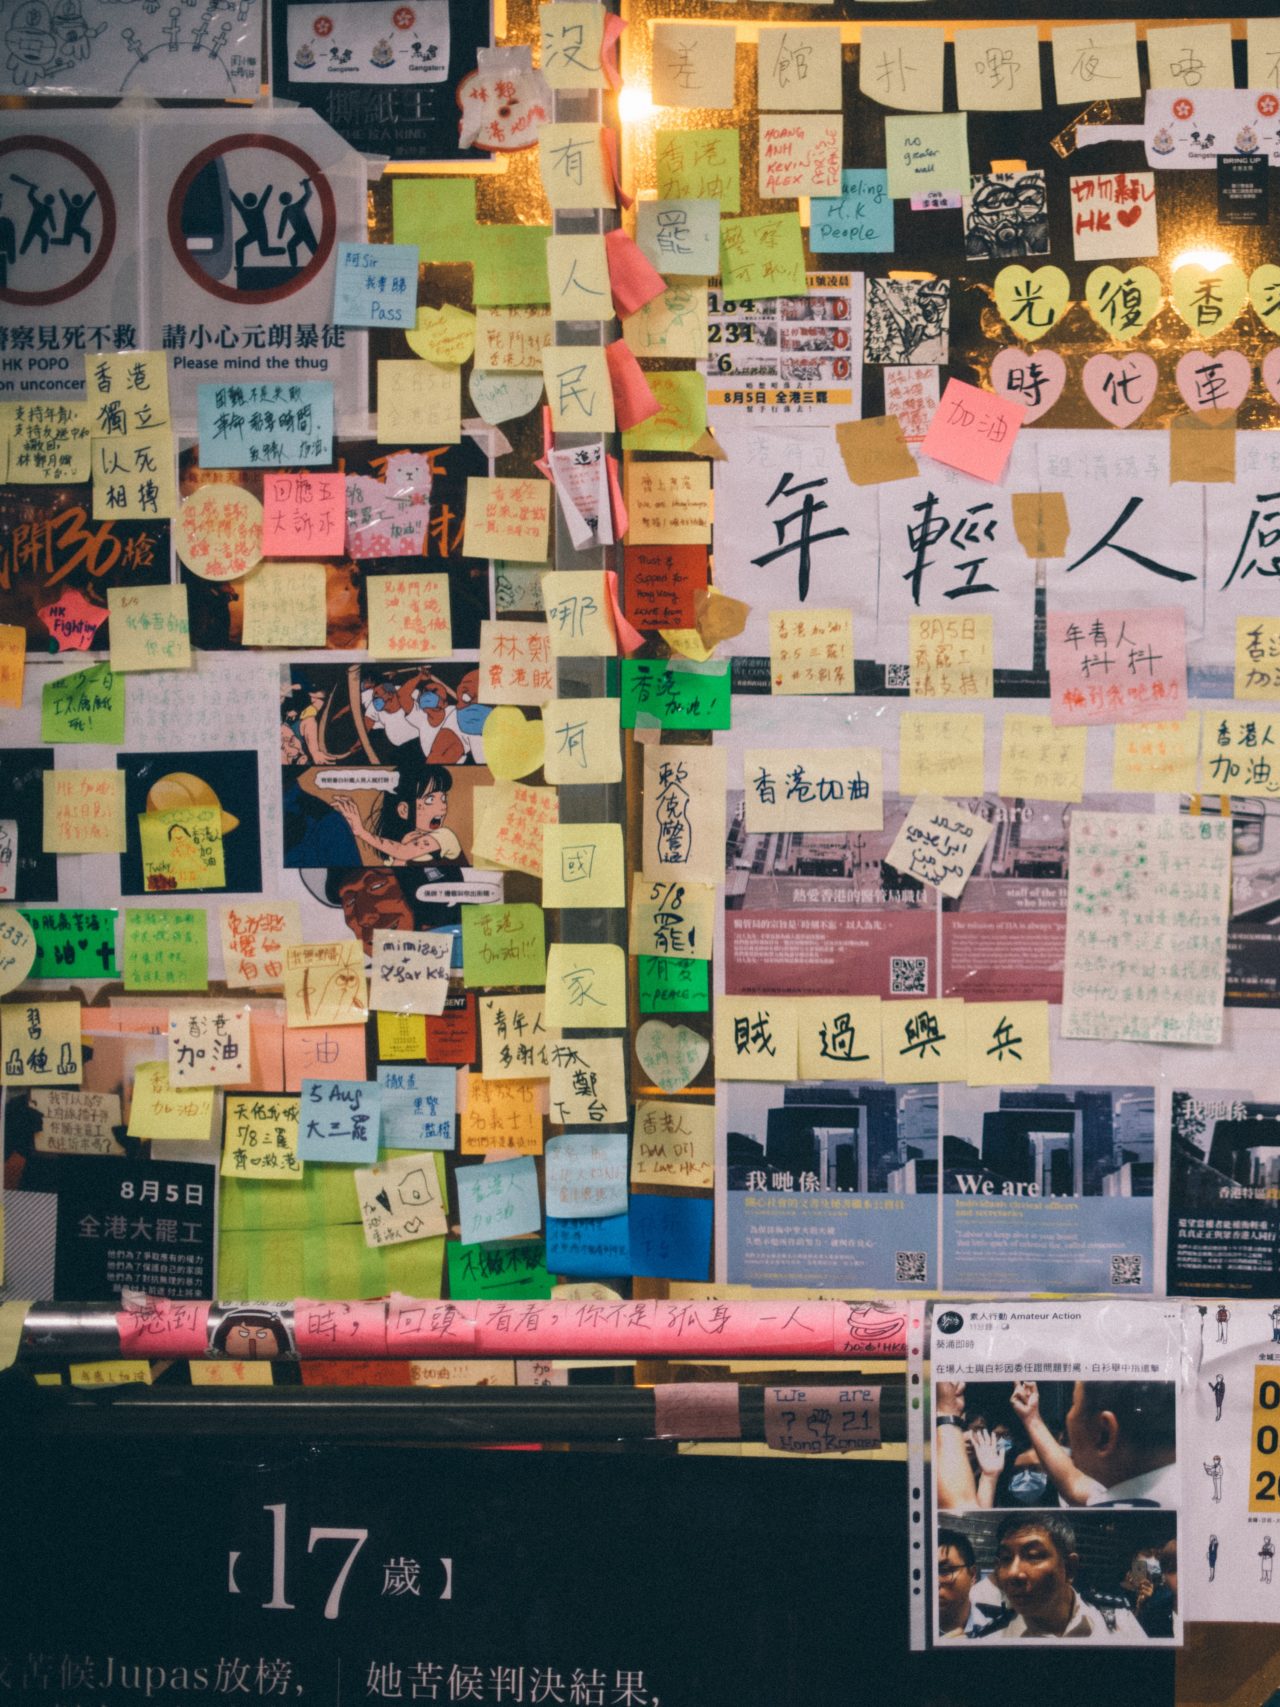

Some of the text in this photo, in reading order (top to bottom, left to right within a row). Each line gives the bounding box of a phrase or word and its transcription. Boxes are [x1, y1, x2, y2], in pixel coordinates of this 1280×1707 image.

[1075, 209, 1112, 236] HK
[370, 301, 403, 321] Pass
[162, 324, 347, 350] 請小心元朗暴徒
[708, 324, 754, 343] 231
[3, 357, 70, 372] HK POPO
[94, 361, 153, 393] 香港
[173, 356, 329, 375] Please mind the thug
[723, 391, 766, 404] 8月5日
[97, 399, 168, 437] 獨立
[949, 398, 1009, 443] 加油
[102, 446, 158, 475] 以死
[272, 510, 337, 539] 大訴求
[1062, 619, 1137, 652] 年青人
[630, 666, 684, 703] 香港
[1216, 722, 1276, 749] 香港人
[749, 765, 872, 805] 香港加油
[1209, 755, 1270, 786] 加油
[650, 881, 688, 912] 5/8
[187, 1015, 233, 1038] 香港
[734, 1009, 1022, 1063] 賊過興兵
[176, 1035, 241, 1068] 加油
[309, 1084, 363, 1111] 5 Aug
[120, 1179, 205, 1208] 8月5日
[955, 1174, 1041, 1196] We are
[77, 1212, 204, 1246] 全港大罷工
[1010, 1311, 1050, 1320] Amateur
[1051, 1311, 1082, 1320] Action
